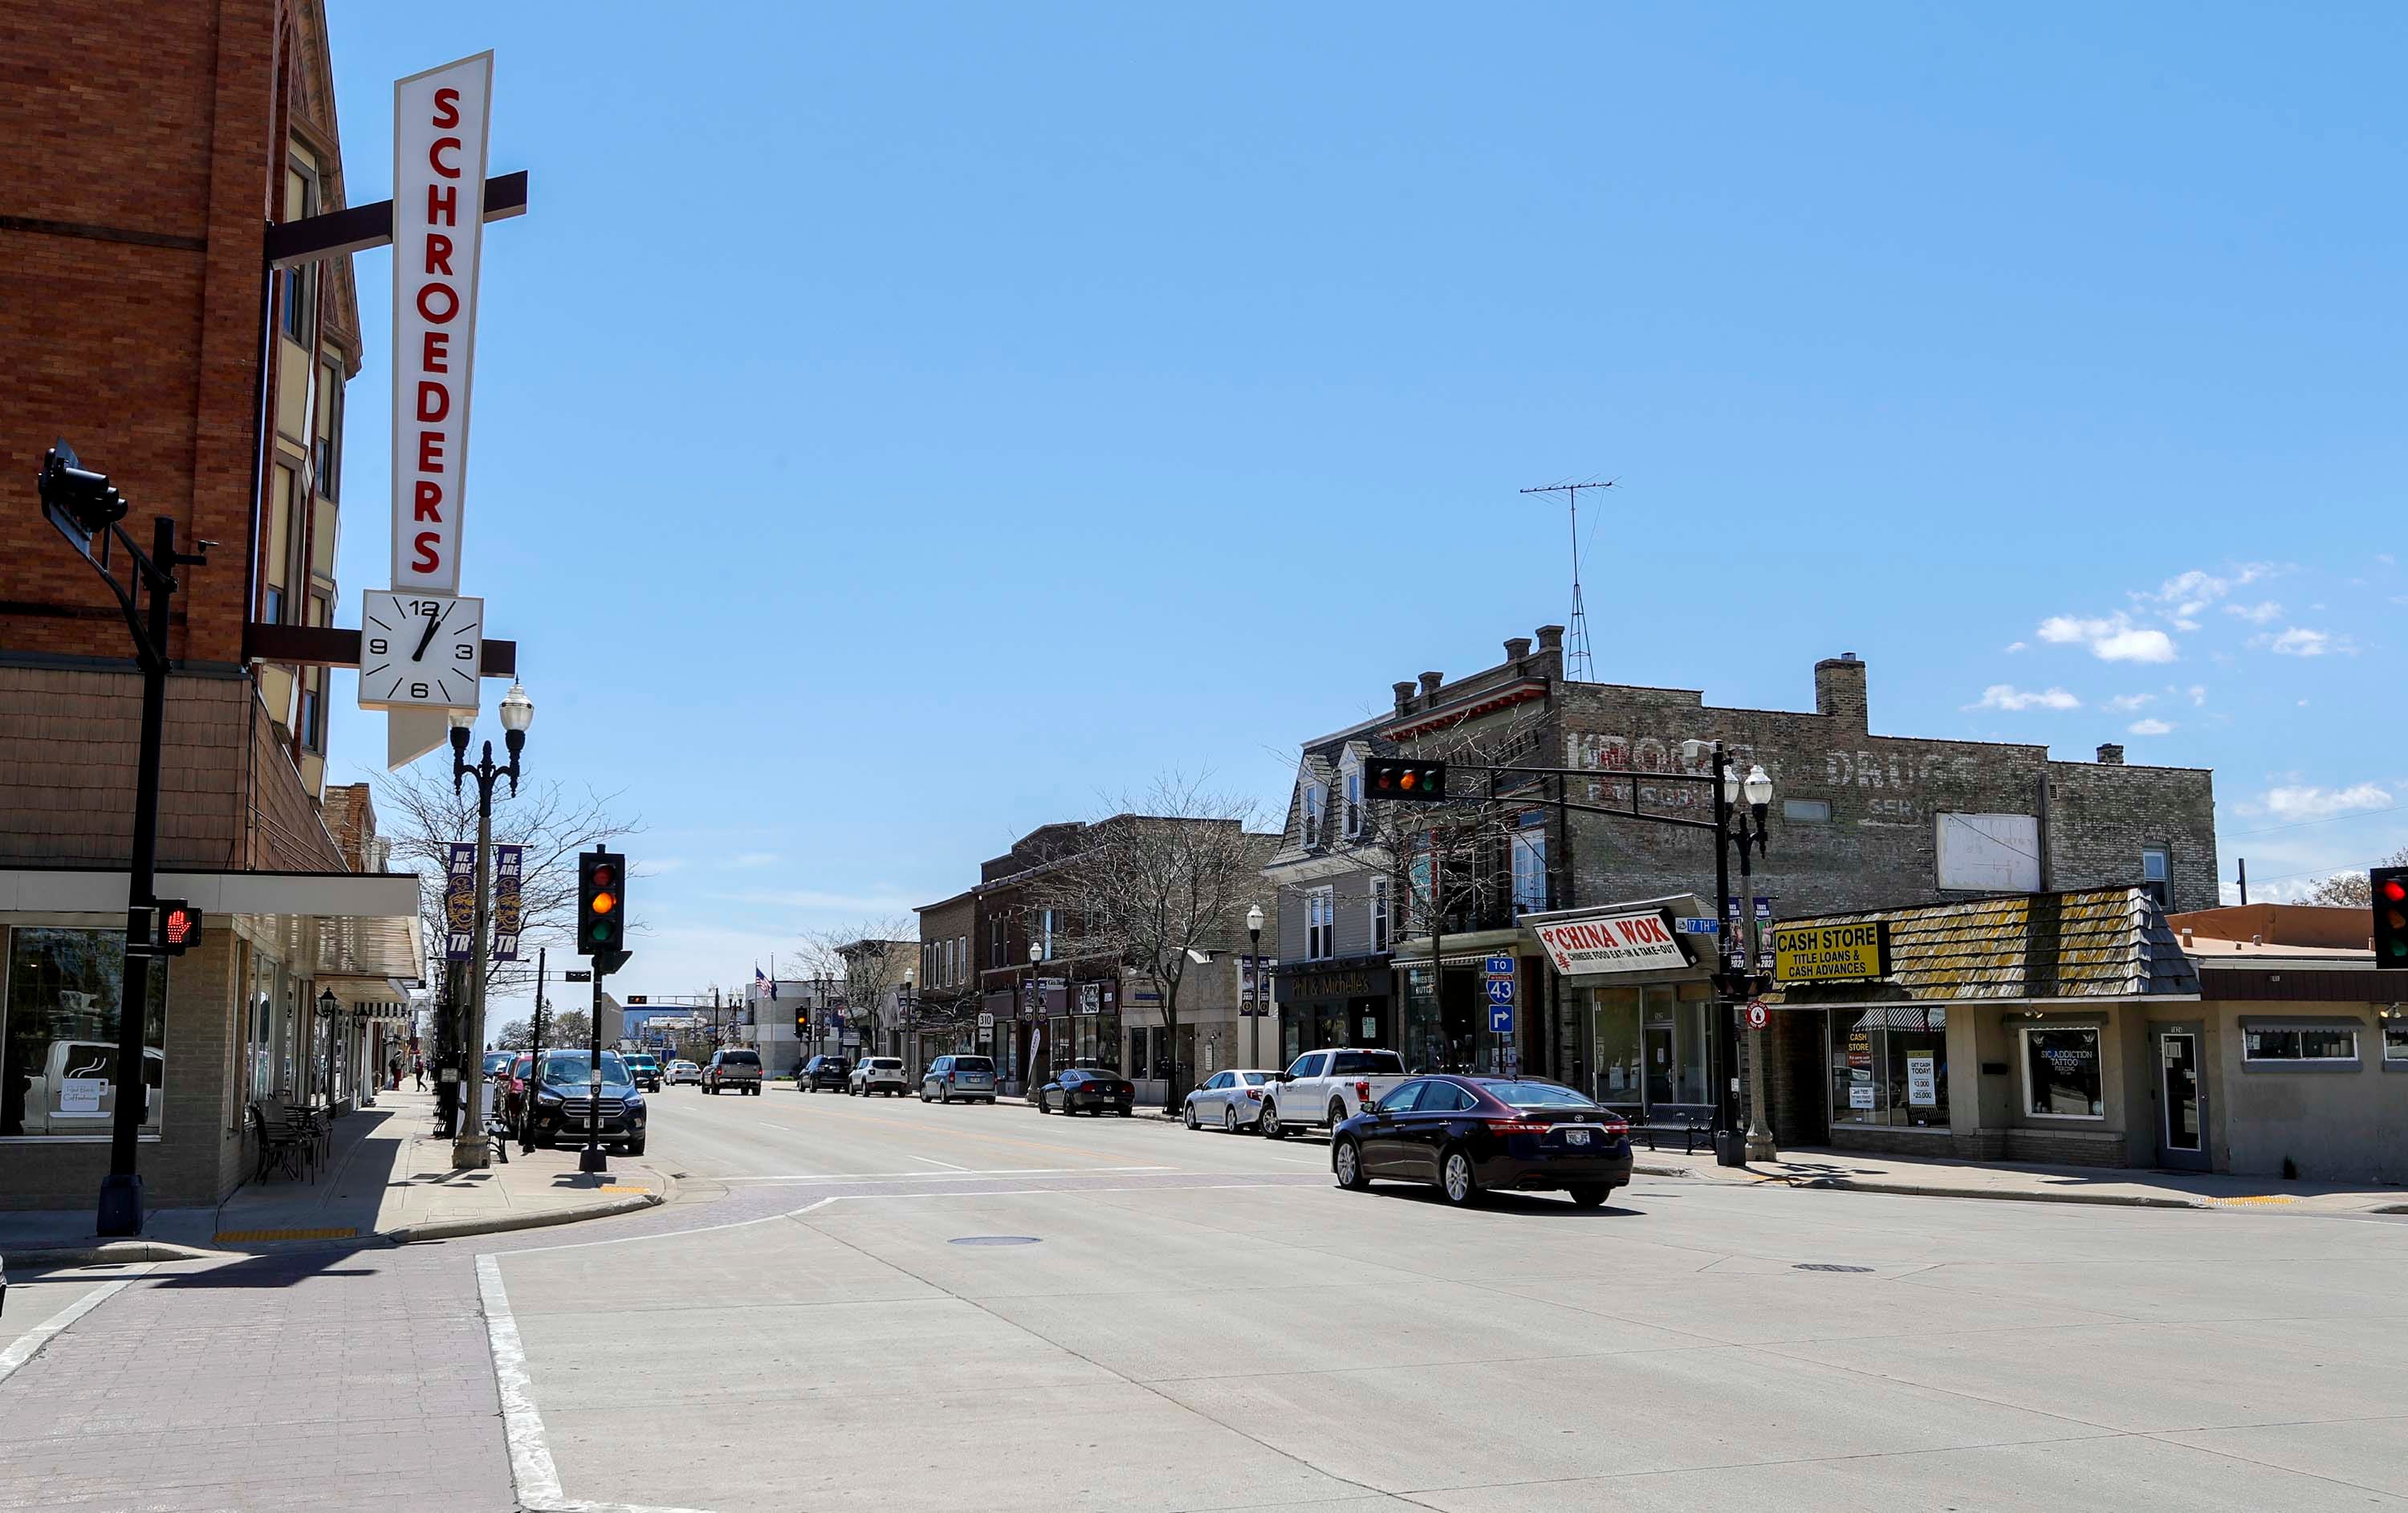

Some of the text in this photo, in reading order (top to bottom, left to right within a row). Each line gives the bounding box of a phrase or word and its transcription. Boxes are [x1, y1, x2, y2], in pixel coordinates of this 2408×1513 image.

[412, 87, 462, 574] SCHROEDERS
[409, 600, 440, 617] 12
[369, 638, 388, 654] 9
[454, 645, 474, 660] 3
[410, 683, 429, 698] 6
[454, 851, 470, 862] WE
[502, 853, 518, 864] WE
[452, 863, 472, 874] ARE
[499, 864, 519, 876] ARE
[1688, 920, 1696, 931] 17
[1556, 917, 1670, 950] CHINA WOK
[1777, 926, 1877, 953] CASH STORE
[449, 934, 470, 951] TR
[496, 935, 517, 953] TR
[1567, 951, 1592, 962] CHINESE
[1592, 950, 1609, 959] FOOD
[1611, 948, 1632, 959] EAT-IN
[1639, 945, 1677, 957] TAKE-OUT
[1793, 950, 1860, 965] TITLE LOANS &
[1492, 961, 1507, 970] TO
[1760, 959, 1774, 967] 2021
[1788, 962, 1866, 977] CASH ADVANCES
[1322, 969, 1369, 995] Michelle's
[1490, 982, 1511, 998] 43
[979, 1015, 991, 1026] 310
[1849, 1033, 1867, 1041] CASH
[1849, 1043, 1869, 1051] STORE
[2054, 1050, 2093, 1059] ADDICTION
[2050, 1058, 2078, 1066] TATTOO
